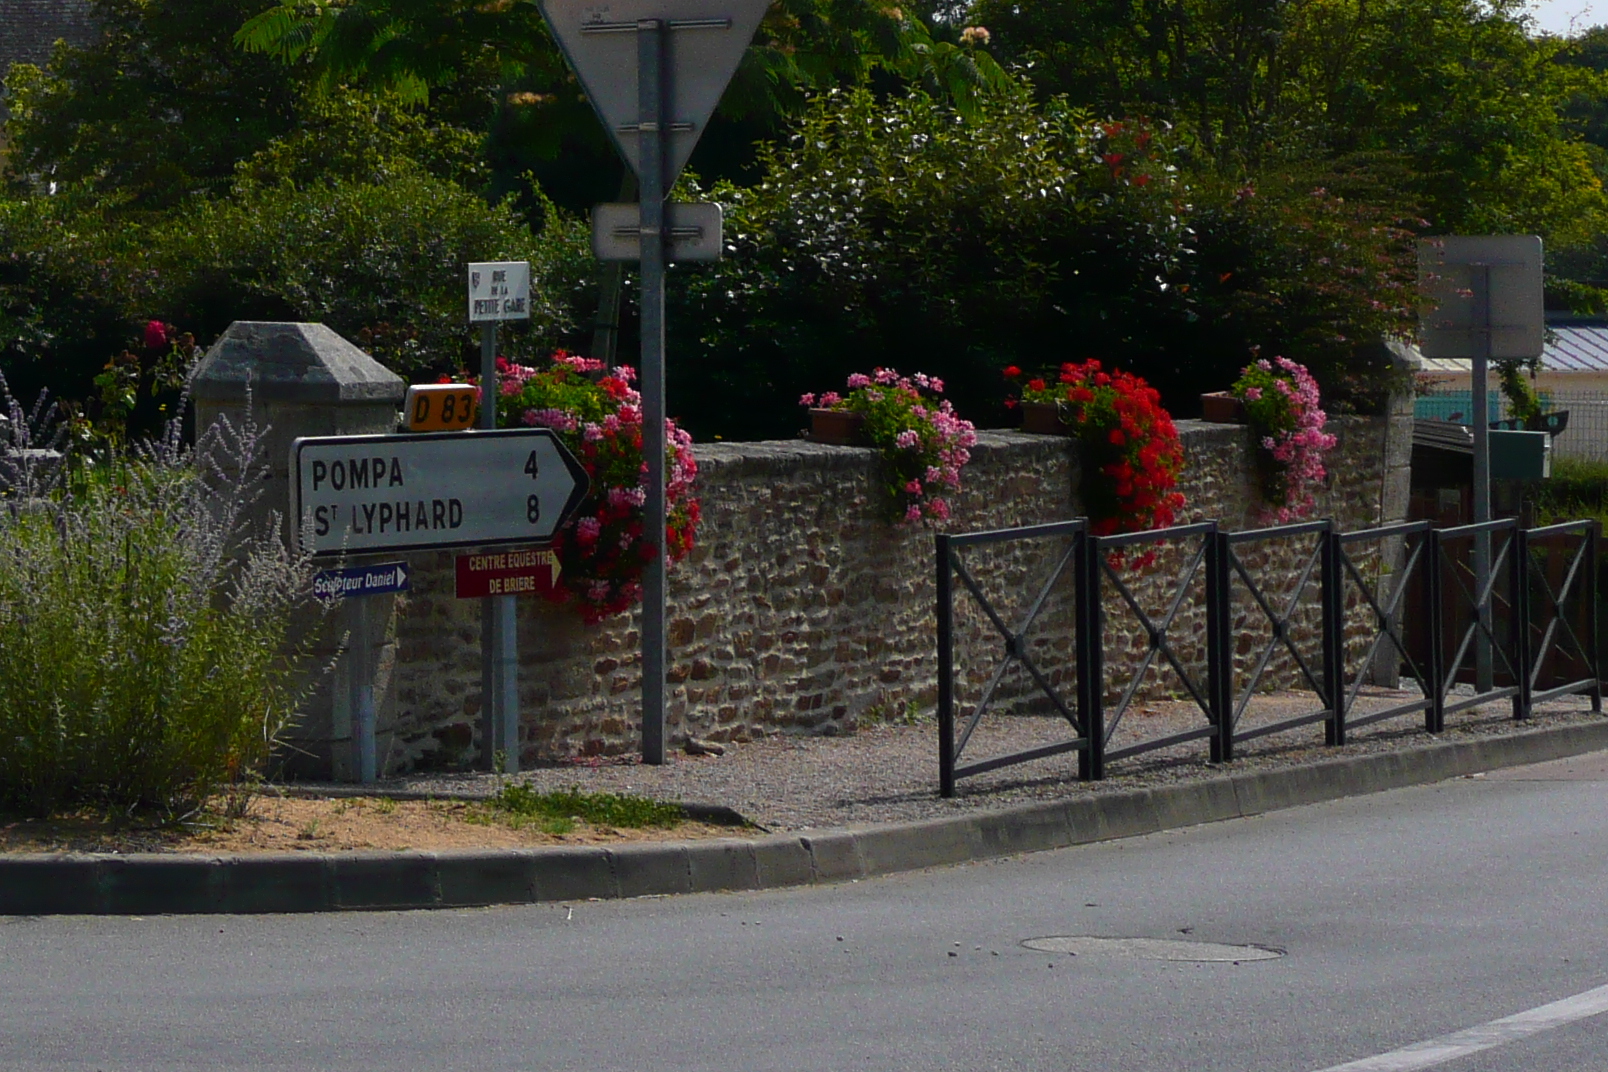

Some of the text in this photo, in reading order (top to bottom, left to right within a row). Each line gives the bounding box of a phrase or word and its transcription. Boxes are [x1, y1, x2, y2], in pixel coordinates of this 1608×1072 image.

[474, 297, 525, 315] PETITE GARE
[414, 393, 473, 424] D 83
[311, 449, 539, 491] POMPA 4
[351, 497, 463, 535] LYPHARD
[526, 494, 540, 524] 8
[469, 548, 554, 572] CENTRE EQUESTRE
[364, 569, 396, 589] Daniel
[489, 575, 536, 594] DE BRIERE
